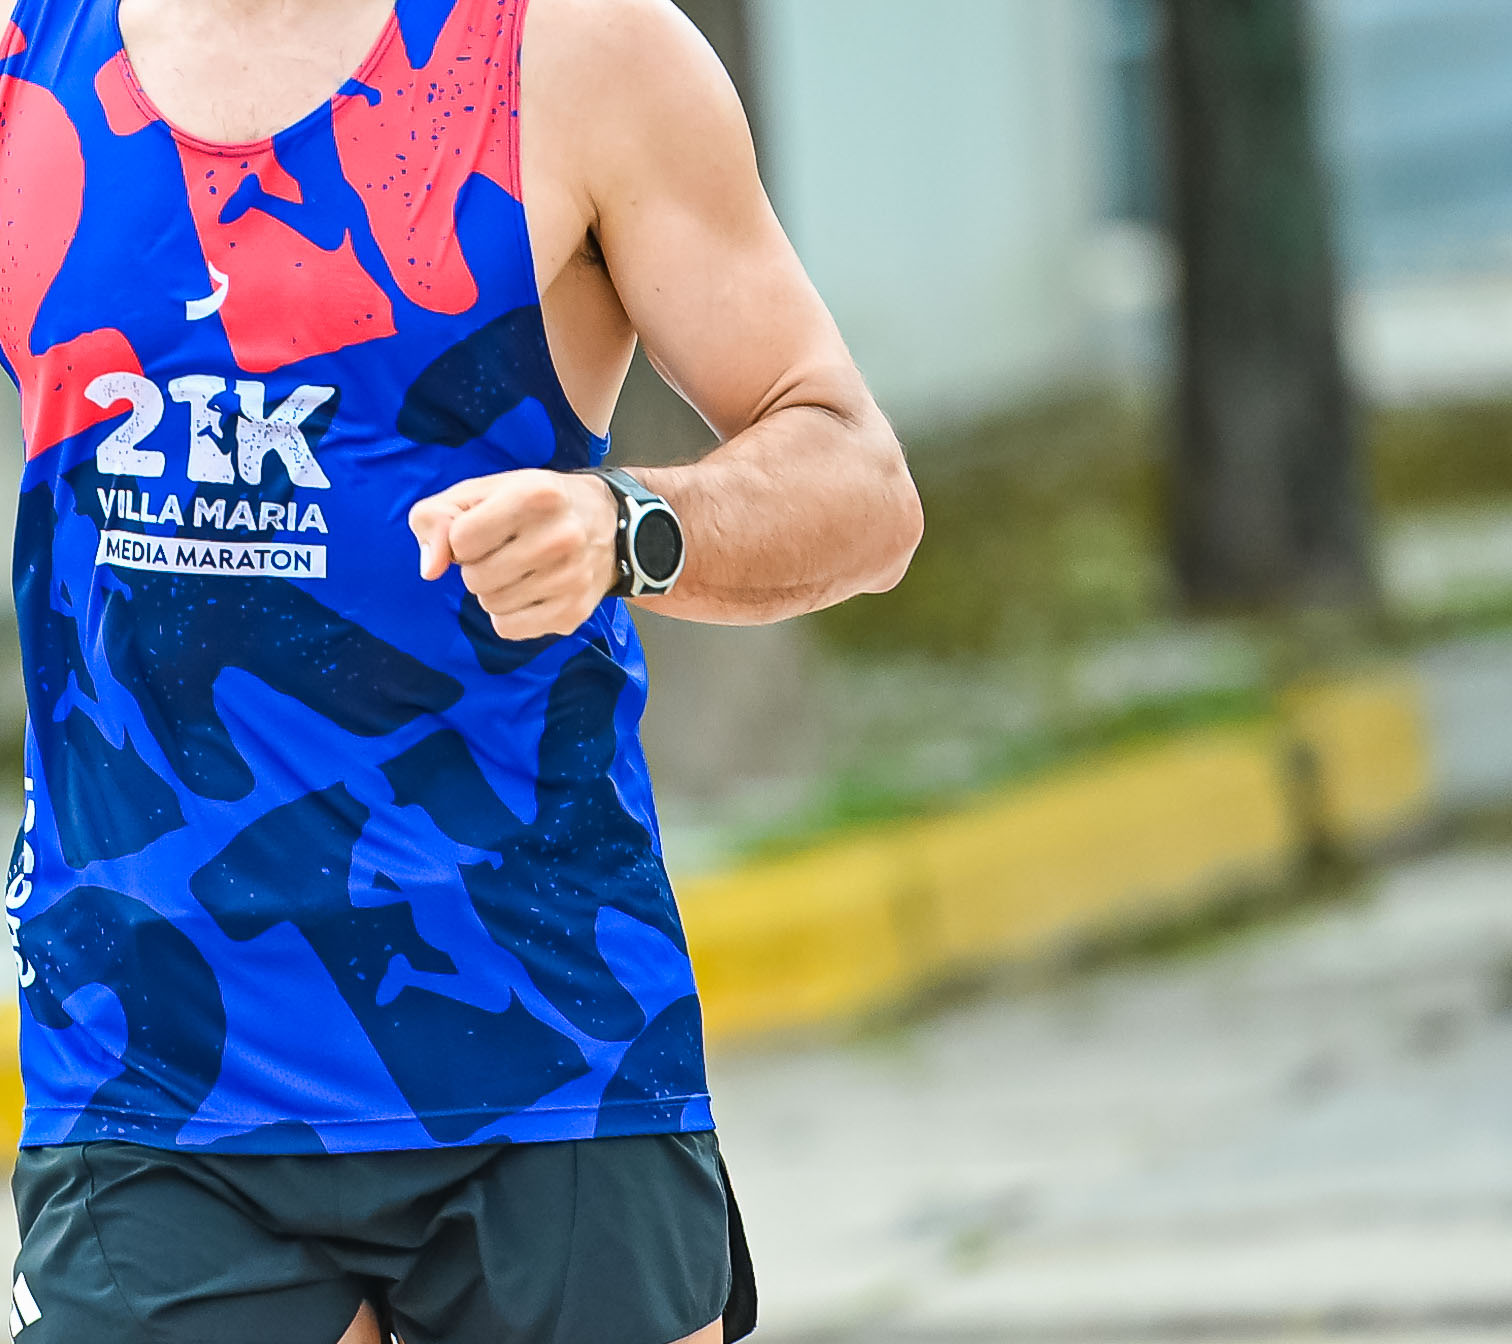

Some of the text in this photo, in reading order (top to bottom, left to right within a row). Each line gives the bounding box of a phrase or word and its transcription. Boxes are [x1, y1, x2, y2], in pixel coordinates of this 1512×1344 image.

[83, 371, 336, 489] 21K
[96, 487, 329, 534] VILLA MARIA
[106, 537, 312, 573] MEDIA MARATON
